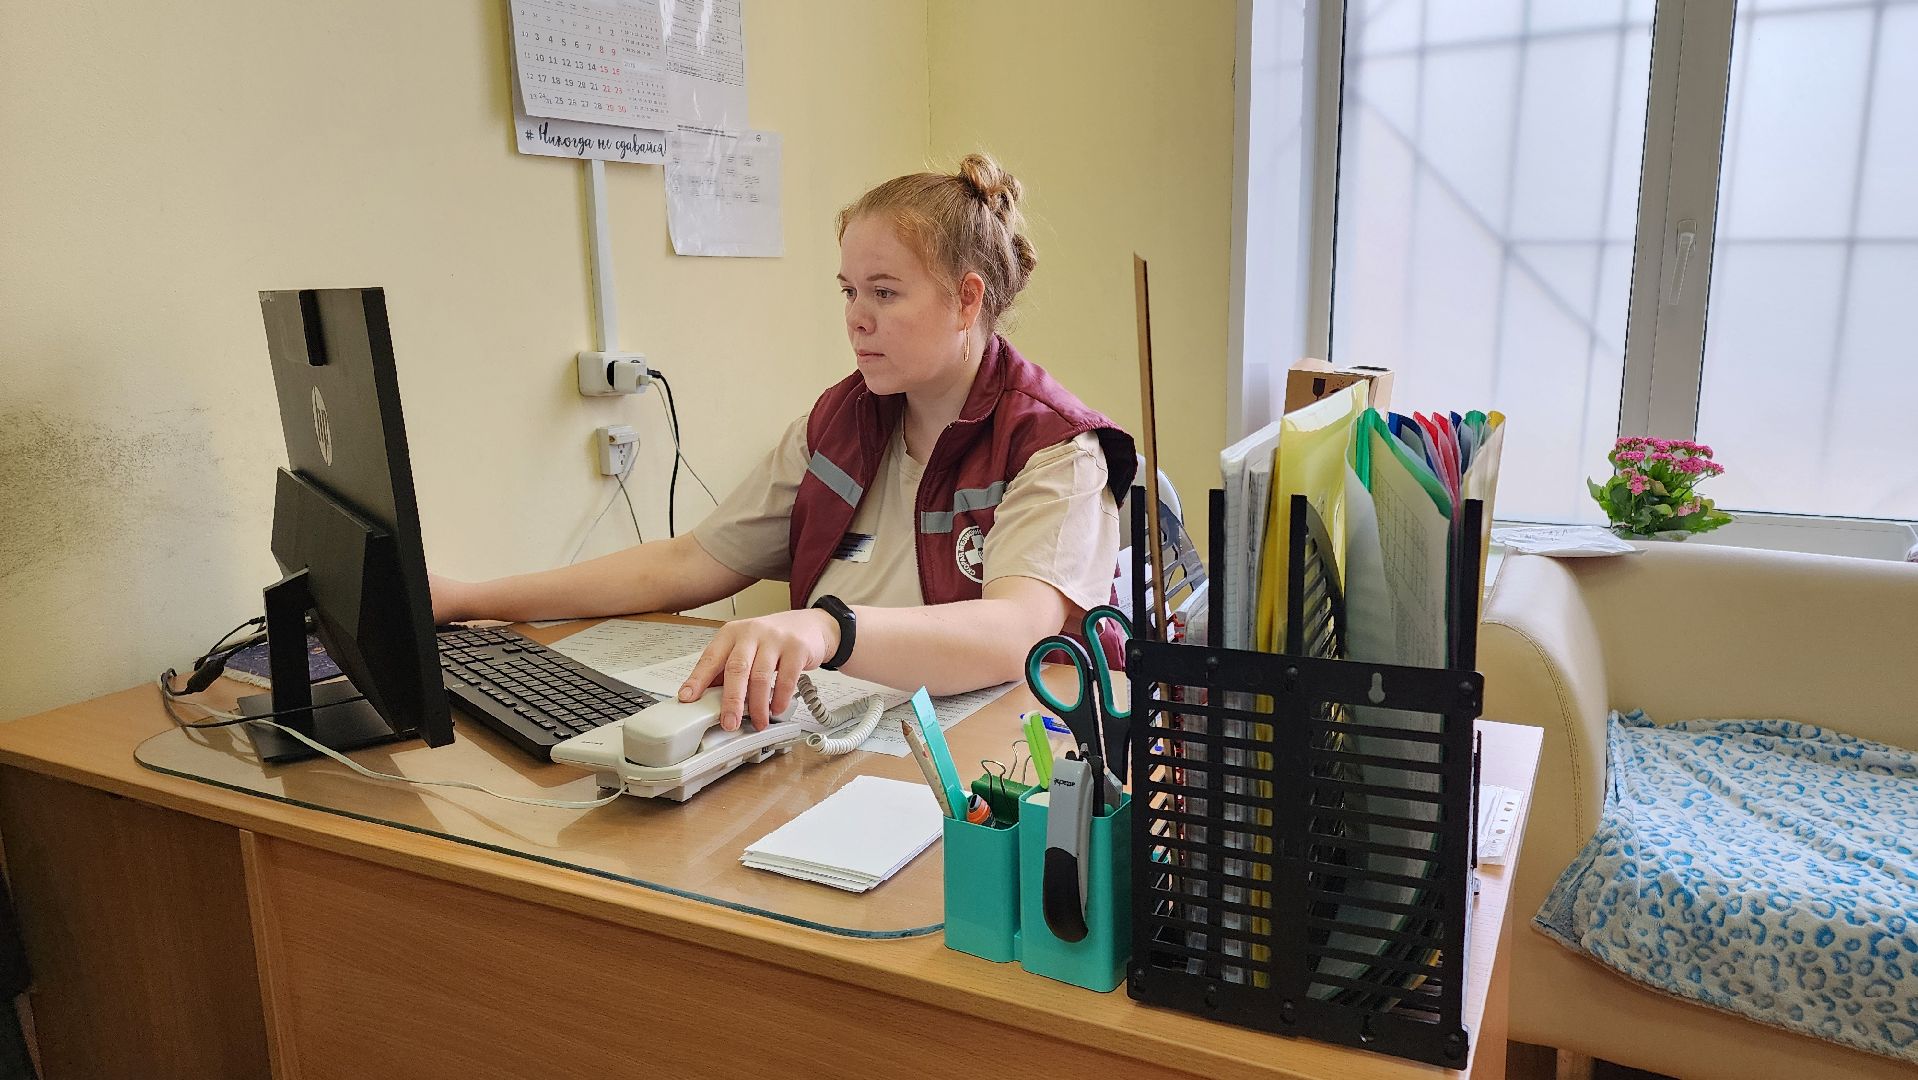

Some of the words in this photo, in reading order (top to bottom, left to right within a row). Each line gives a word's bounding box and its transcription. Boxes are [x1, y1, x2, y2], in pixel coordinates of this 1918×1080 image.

[534, 33, 540, 41] 3
[561, 38, 567, 46] 5
[535, 54, 544, 62] 10
[548, 56, 558, 64] 11
[562, 58, 572, 68] 12
[575, 60, 584, 70] 13
[588, 63, 596, 71] 14
[600, 66, 608, 74] 15
[538, 74, 546, 82] 17
[552, 76, 560, 84] 18
[564, 78, 574, 86] 19
[590, 82, 598, 91] 21
[554, 96, 564, 105] 25
[538, 121, 595, 156] Никогда
[597, 138, 613, 150] не
[615, 133, 667, 160] сдавайся!
